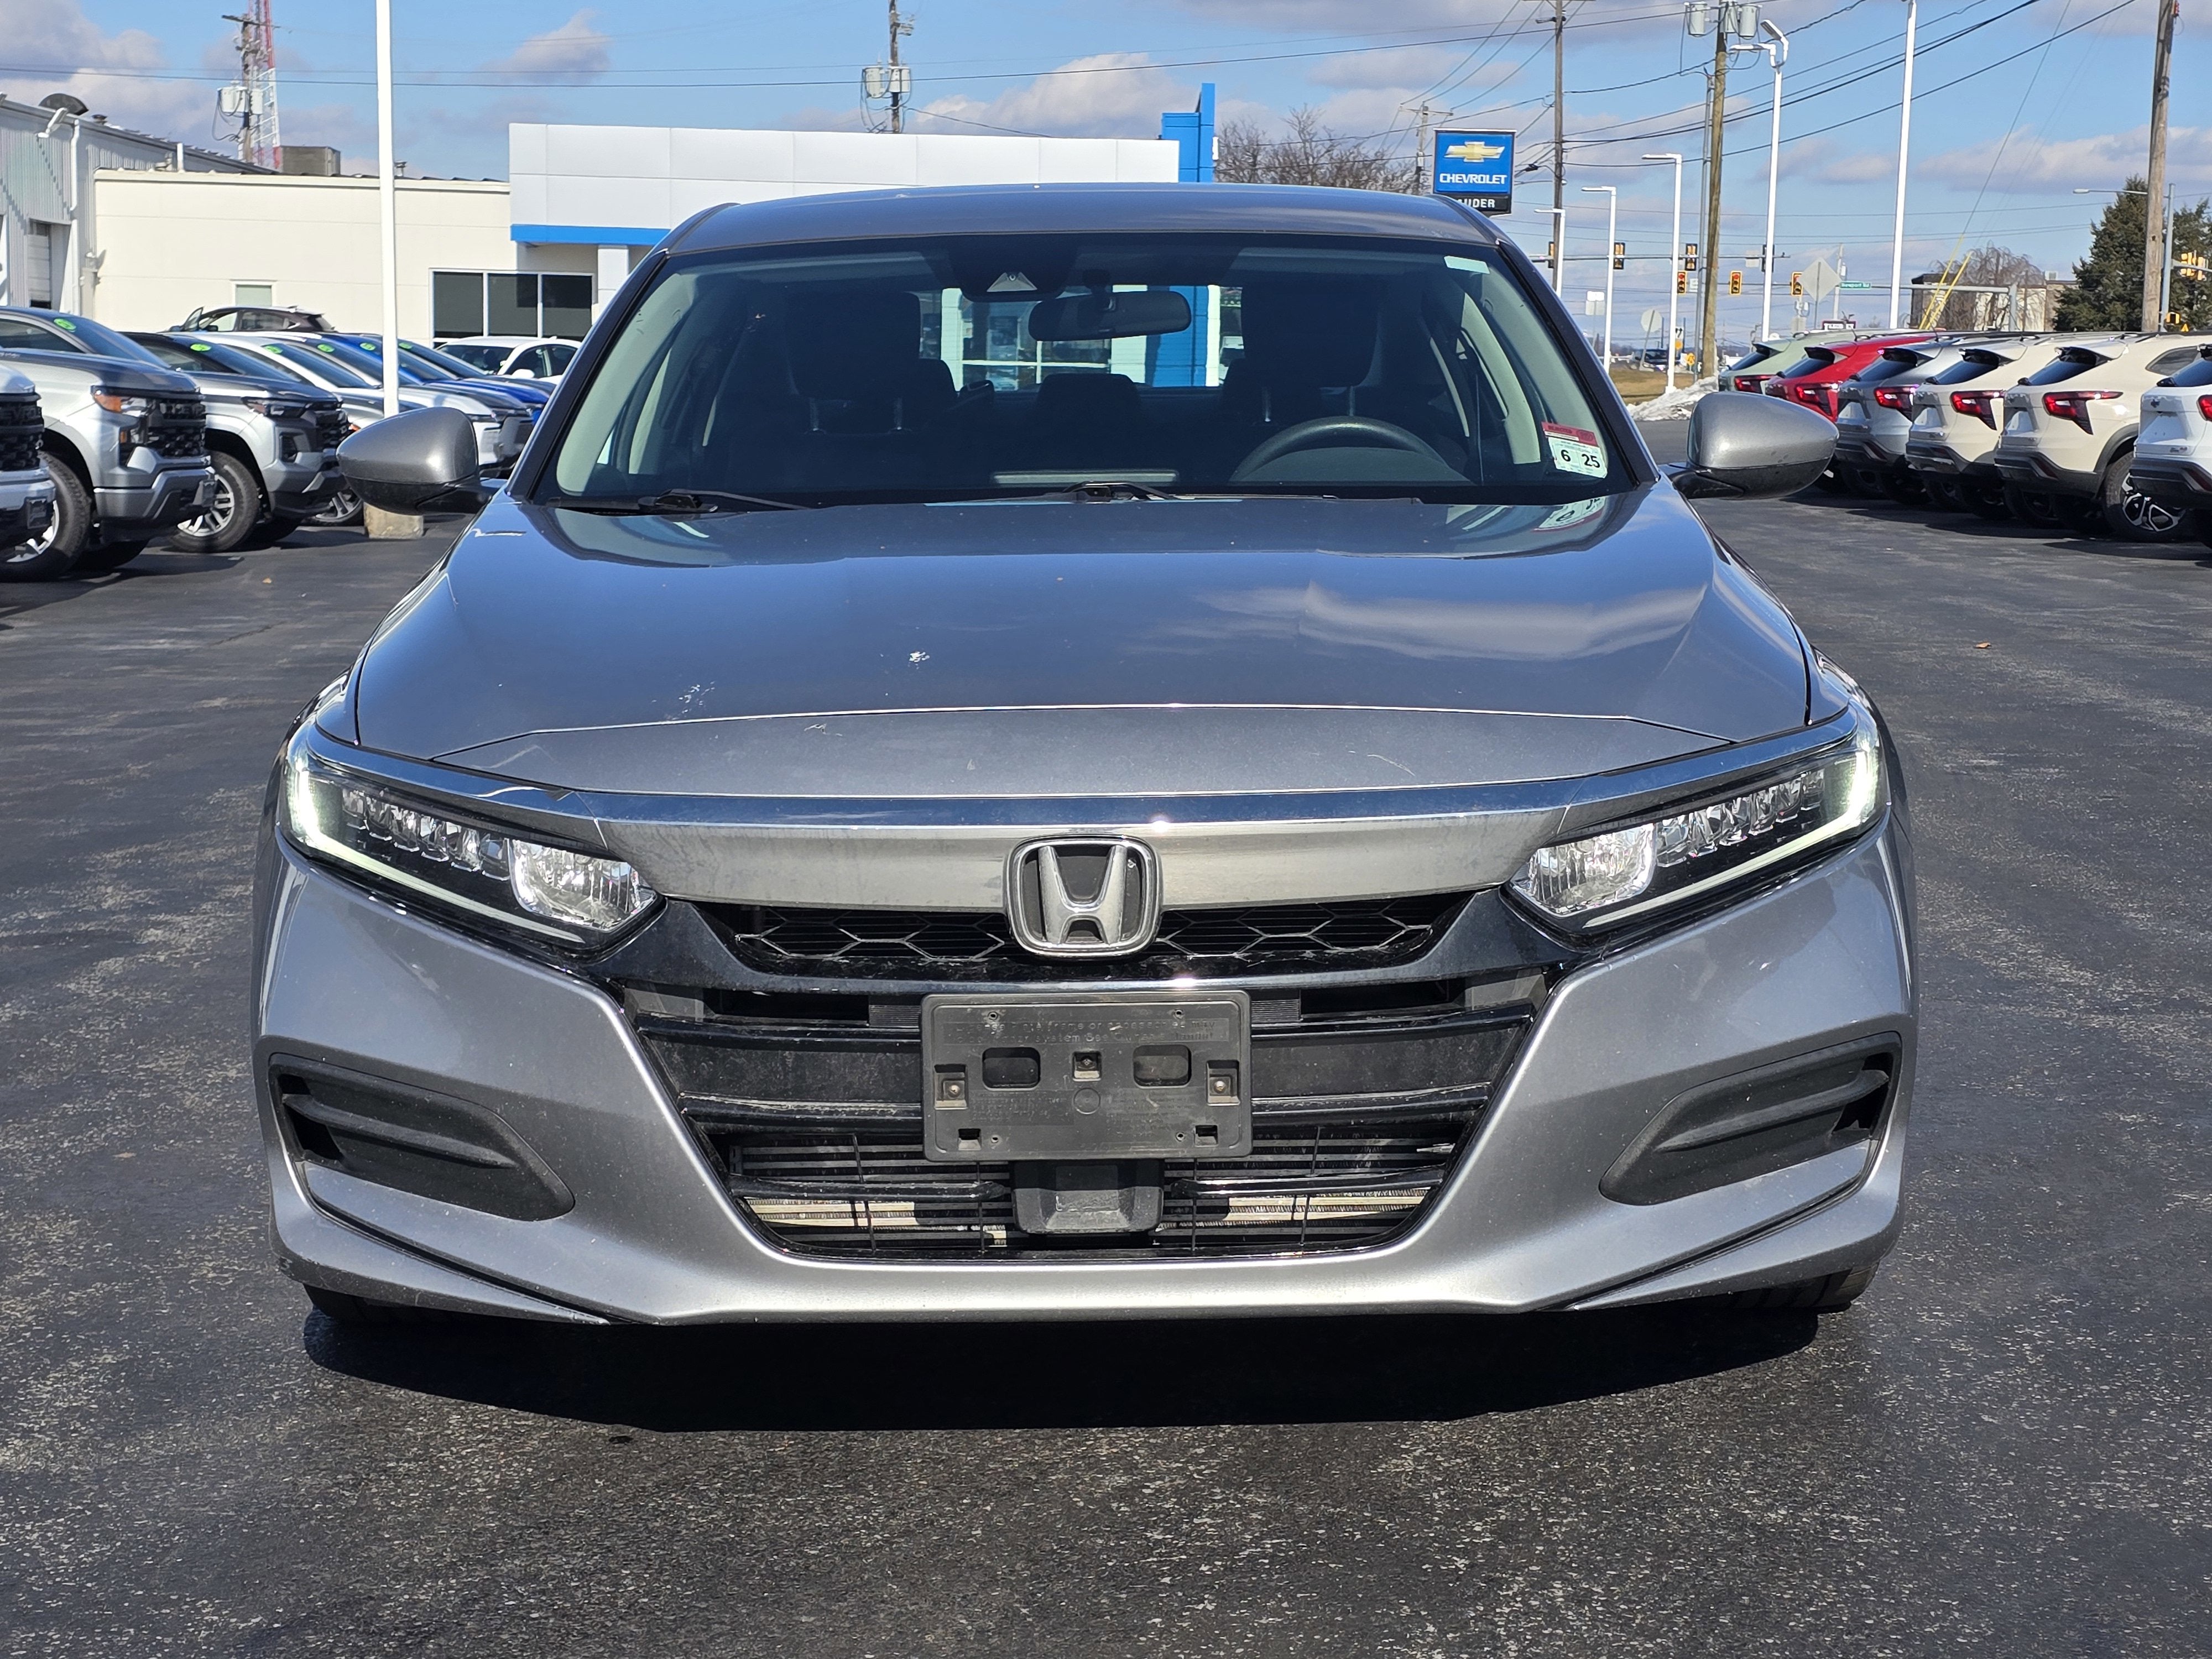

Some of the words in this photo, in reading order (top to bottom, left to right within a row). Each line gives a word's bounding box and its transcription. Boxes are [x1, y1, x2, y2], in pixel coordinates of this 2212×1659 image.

[1439, 173, 1507, 184] CHEVROLET
[1561, 450, 1571, 462] 6
[1582, 453, 1600, 468] 25
